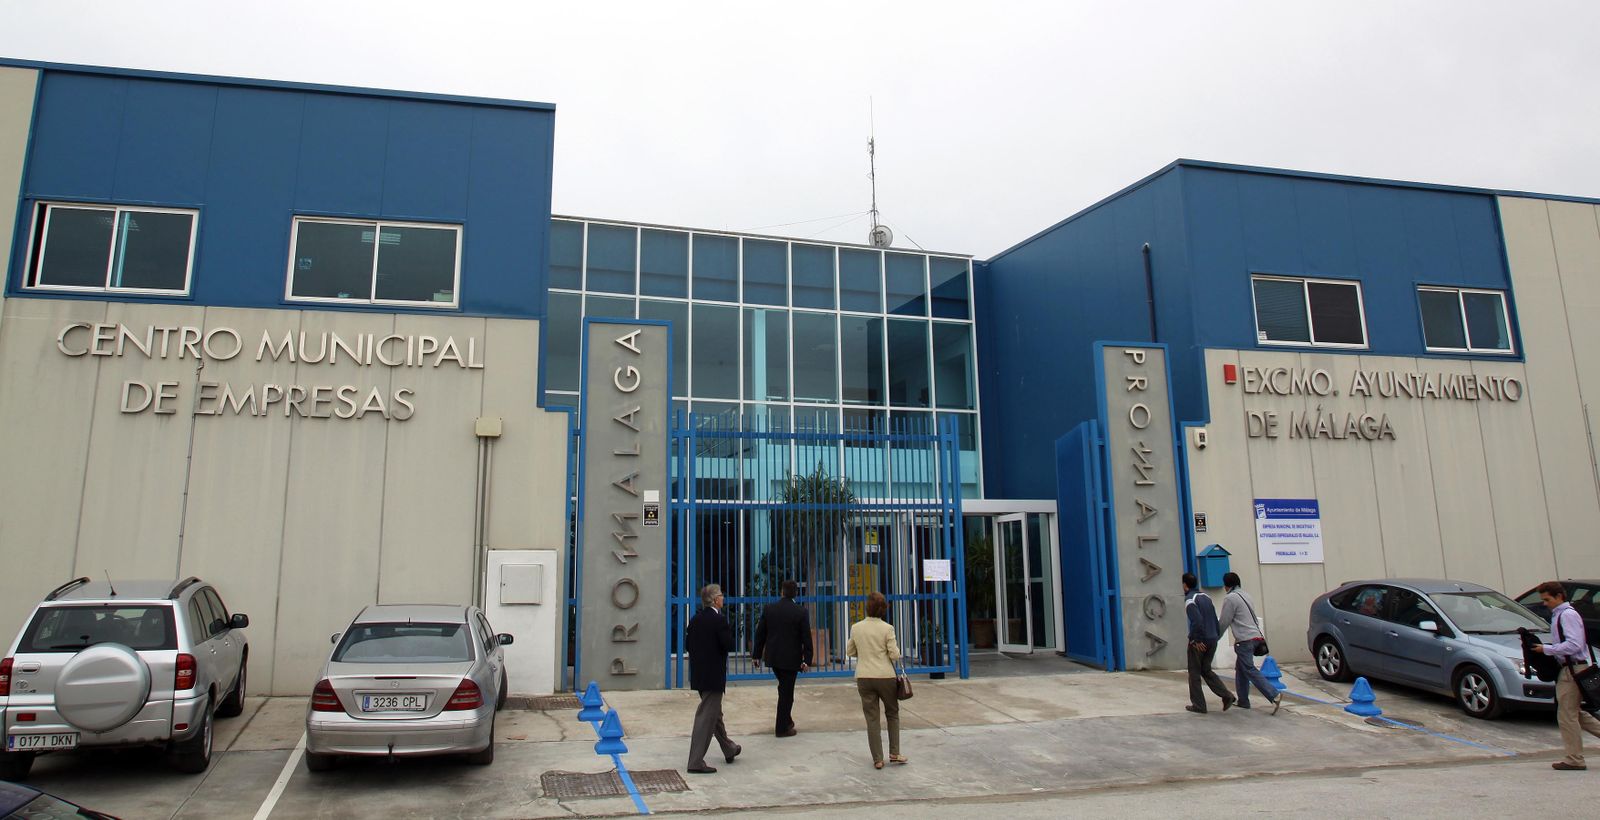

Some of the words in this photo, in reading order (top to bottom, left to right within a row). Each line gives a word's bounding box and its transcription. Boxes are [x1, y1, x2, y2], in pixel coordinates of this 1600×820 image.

[57, 321, 243, 361] CENTRO
[256, 329, 485, 369] MUNICIPAL
[120, 379, 180, 414] DE
[193, 381, 415, 421] EMPRESAS
[1242, 367, 1338, 396] EXCMO.
[1349, 369, 1523, 402] AYUNTAMIENTO
[1246, 410, 1279, 439] DE
[1290, 403, 1396, 440] MÁLAGA
[610, 329, 642, 675] PROMALAGA
[1124, 349, 1168, 658] PROMALAGA
[373, 697, 398, 708] 3236
[402, 696, 421, 707] CPL
[20, 736, 46, 747] 0171
[51, 735, 73, 746] DKN
